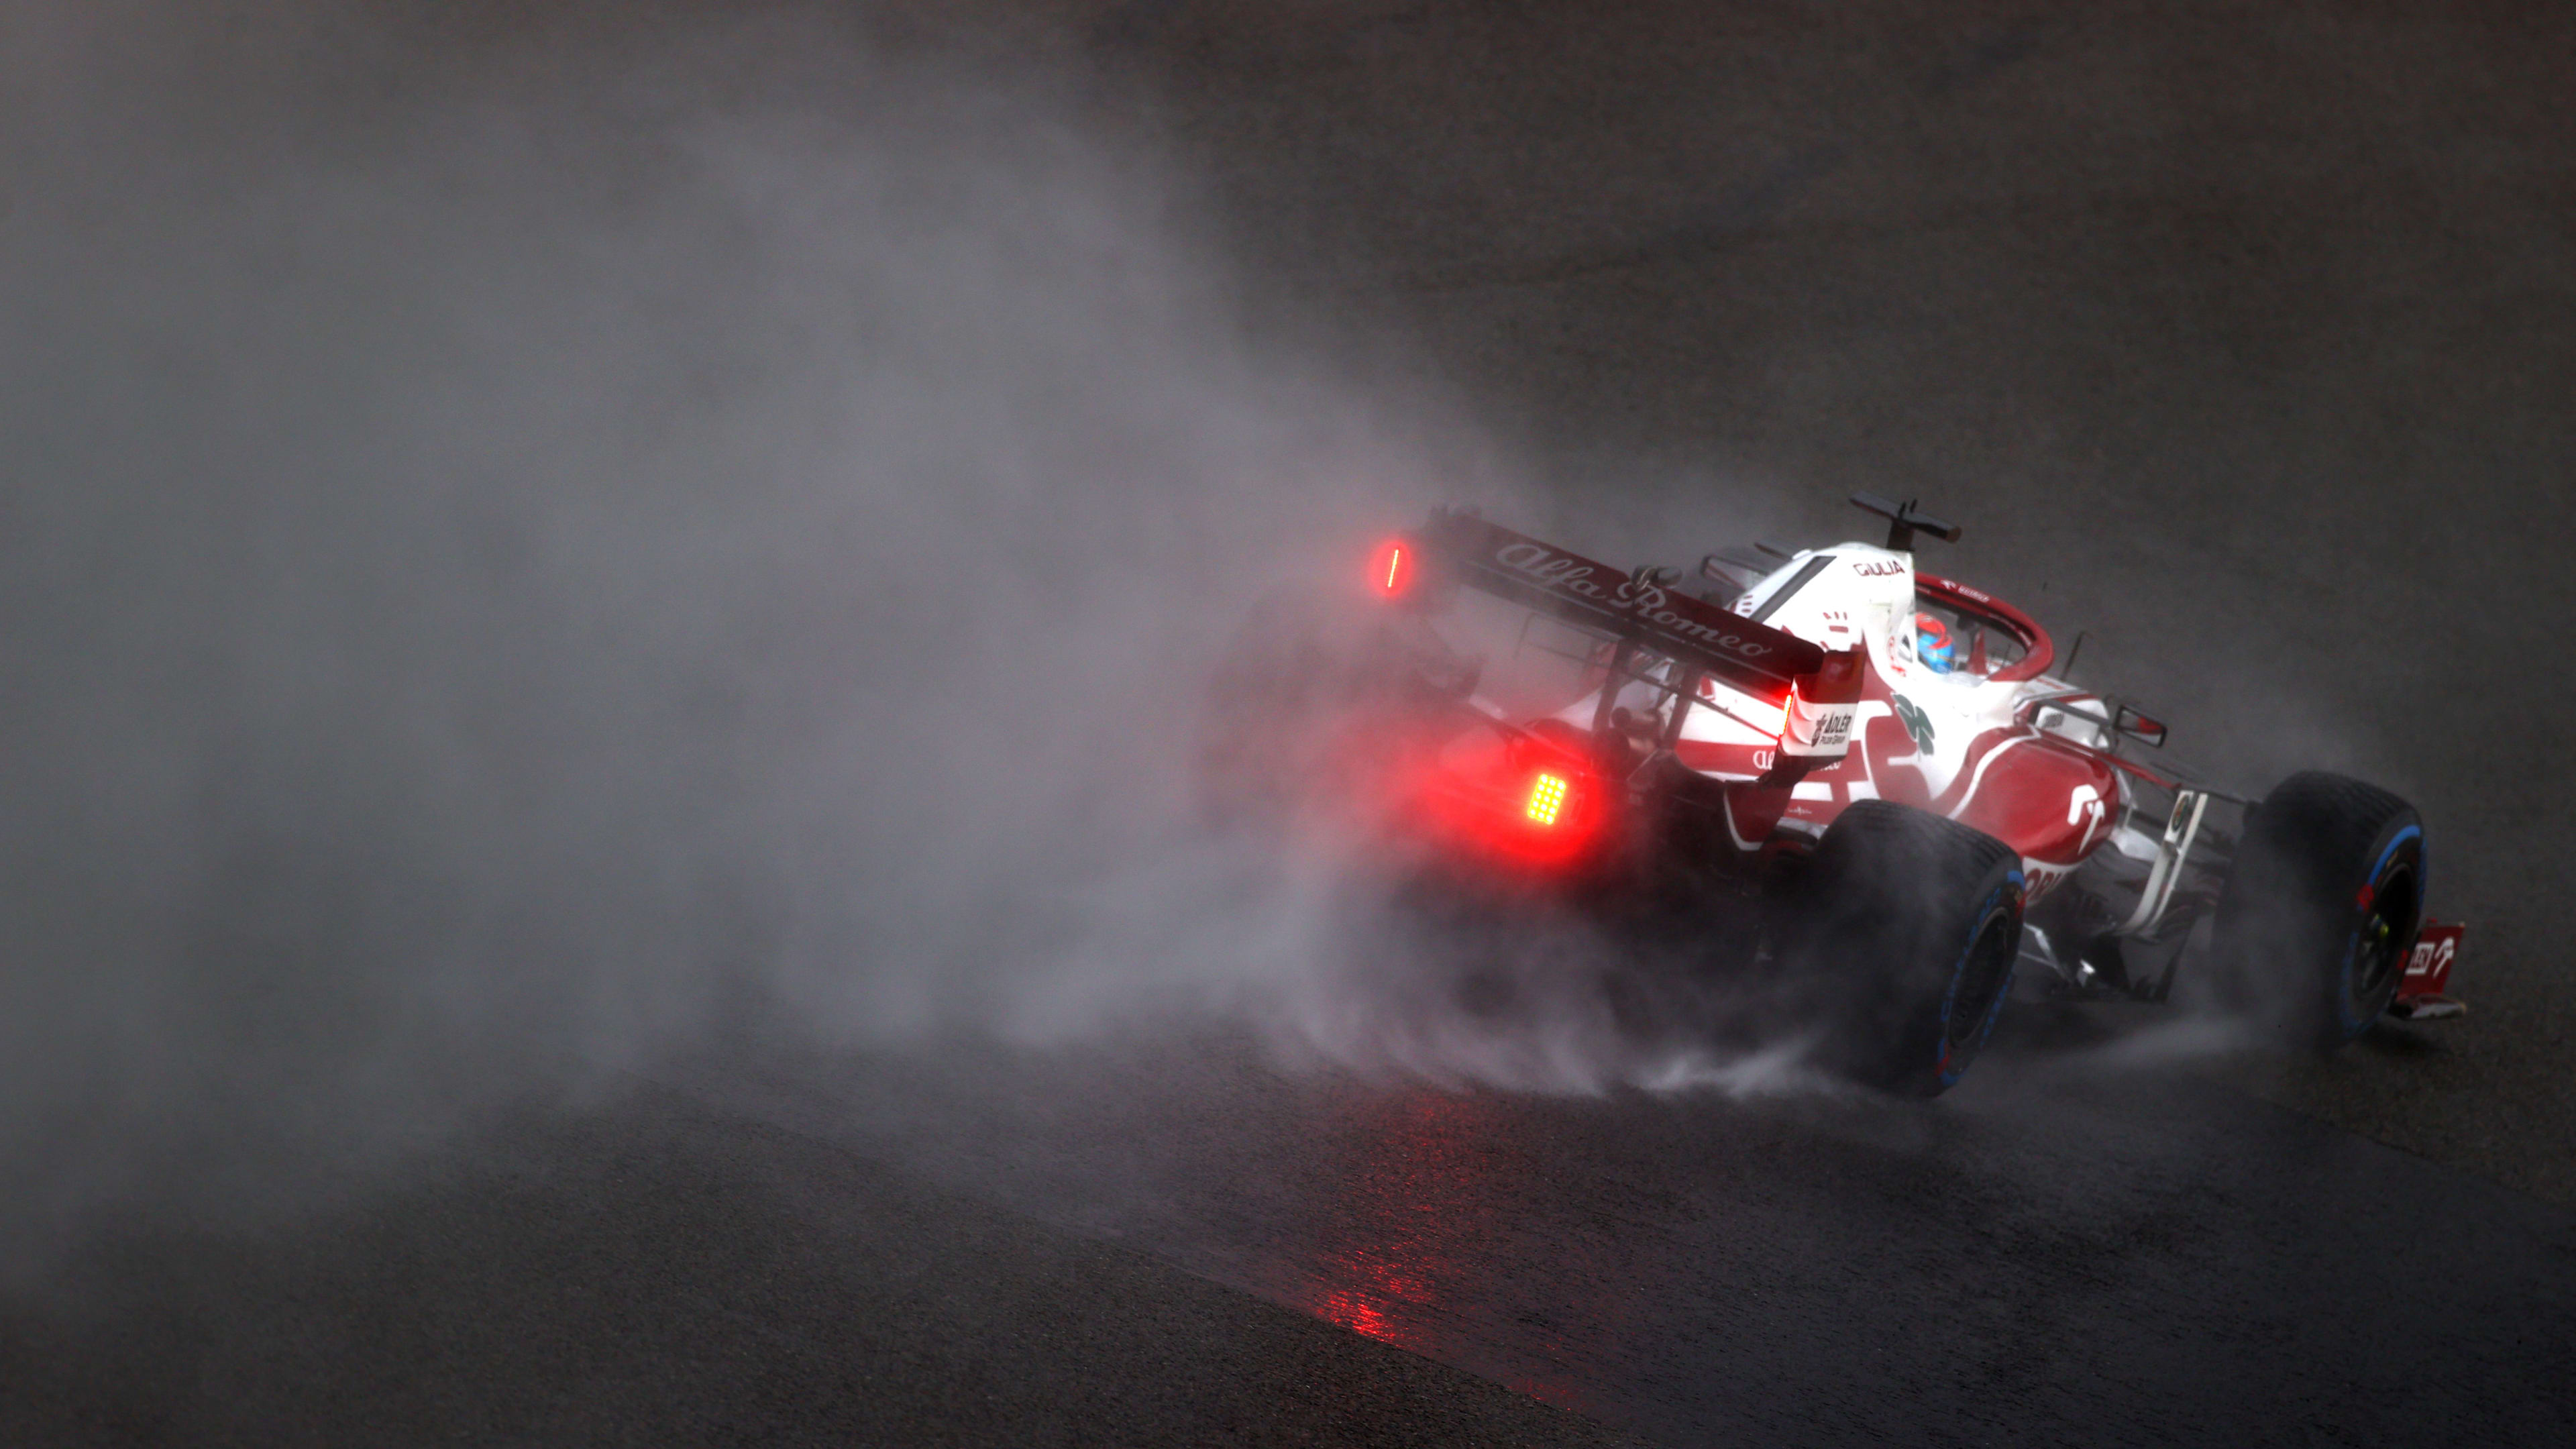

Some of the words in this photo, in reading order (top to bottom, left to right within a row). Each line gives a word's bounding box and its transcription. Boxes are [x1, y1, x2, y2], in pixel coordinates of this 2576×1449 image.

[1497, 543, 1607, 600] Alfa
[1610, 580, 1772, 657] Romeo
[1852, 560, 1906, 577] GIULIA
